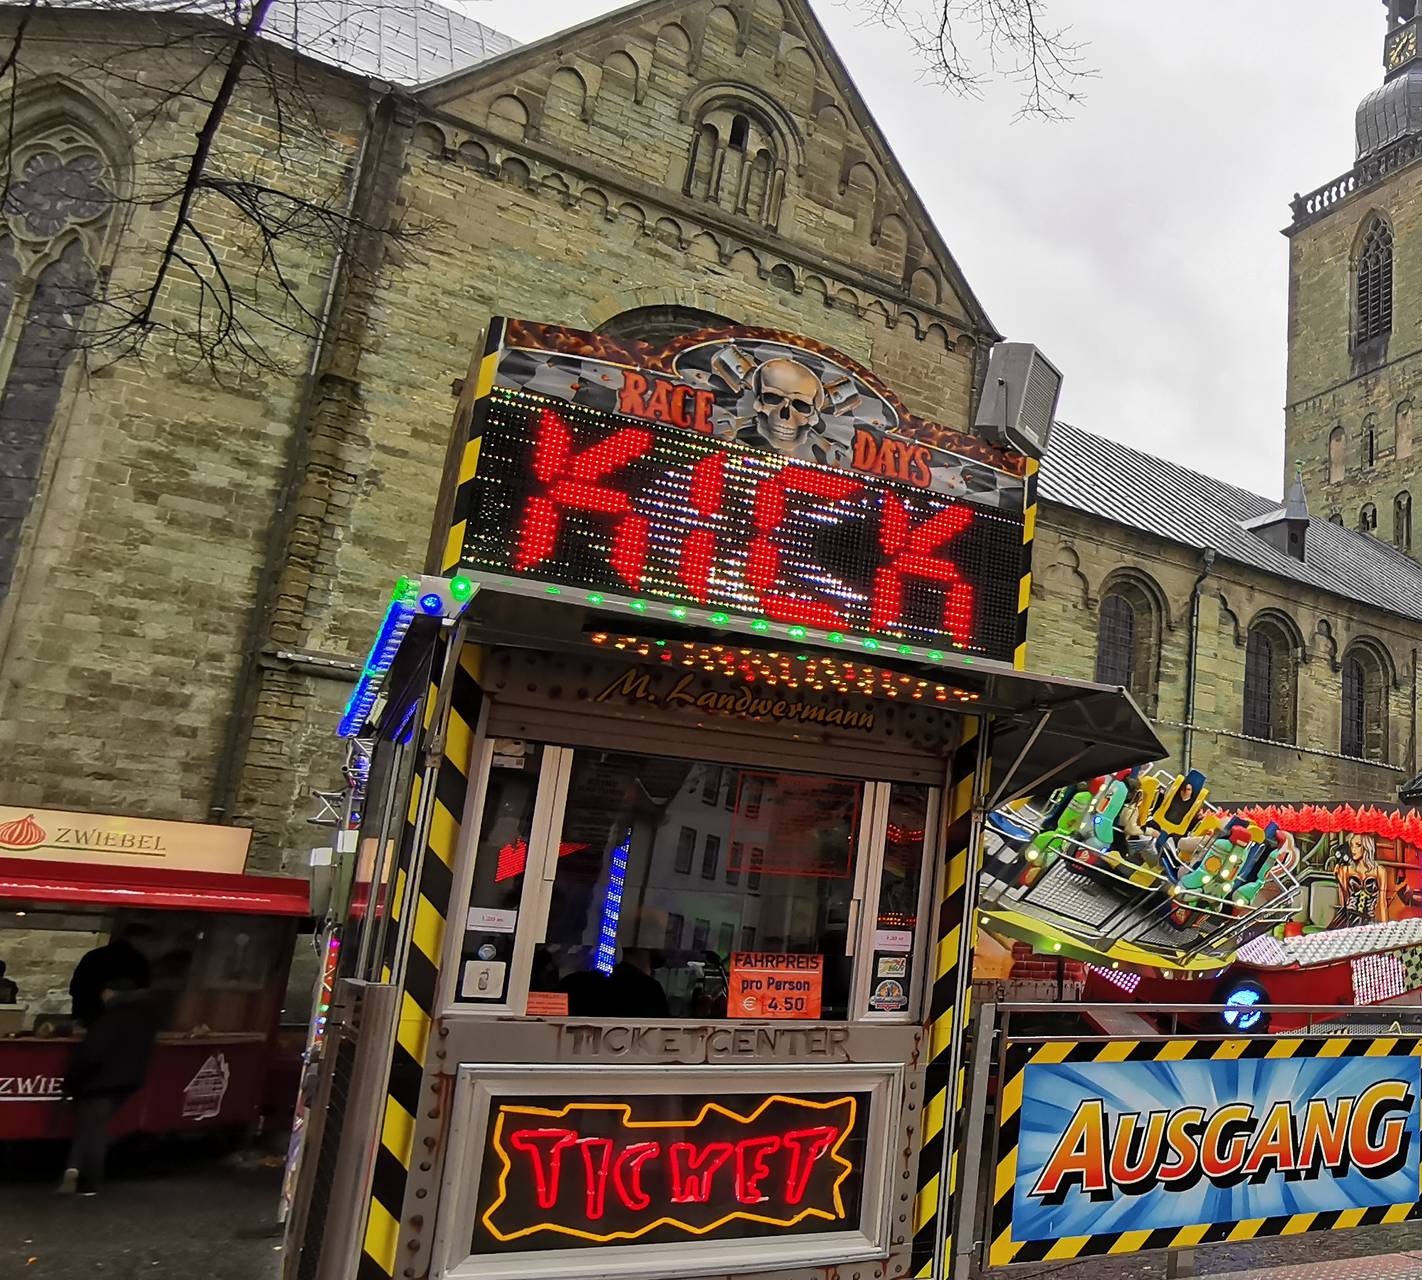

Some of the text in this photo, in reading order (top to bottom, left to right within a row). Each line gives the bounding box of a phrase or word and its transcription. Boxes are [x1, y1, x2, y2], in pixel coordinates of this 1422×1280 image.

[619, 370, 933, 488] RACE DAYS
[512, 408, 975, 650] KICK
[599, 667, 876, 731] M. Landwermann
[55, 827, 167, 851] ZWIEBEL
[734, 953, 820, 970] FAHRPREIS
[741, 977, 810, 993] pro Person
[768, 996, 805, 1011] 4.50
[566, 1026, 849, 1058] TICKET CENTER
[1028, 1079, 1415, 1206] AUSGANG
[511, 1126, 837, 1219] TICKET
